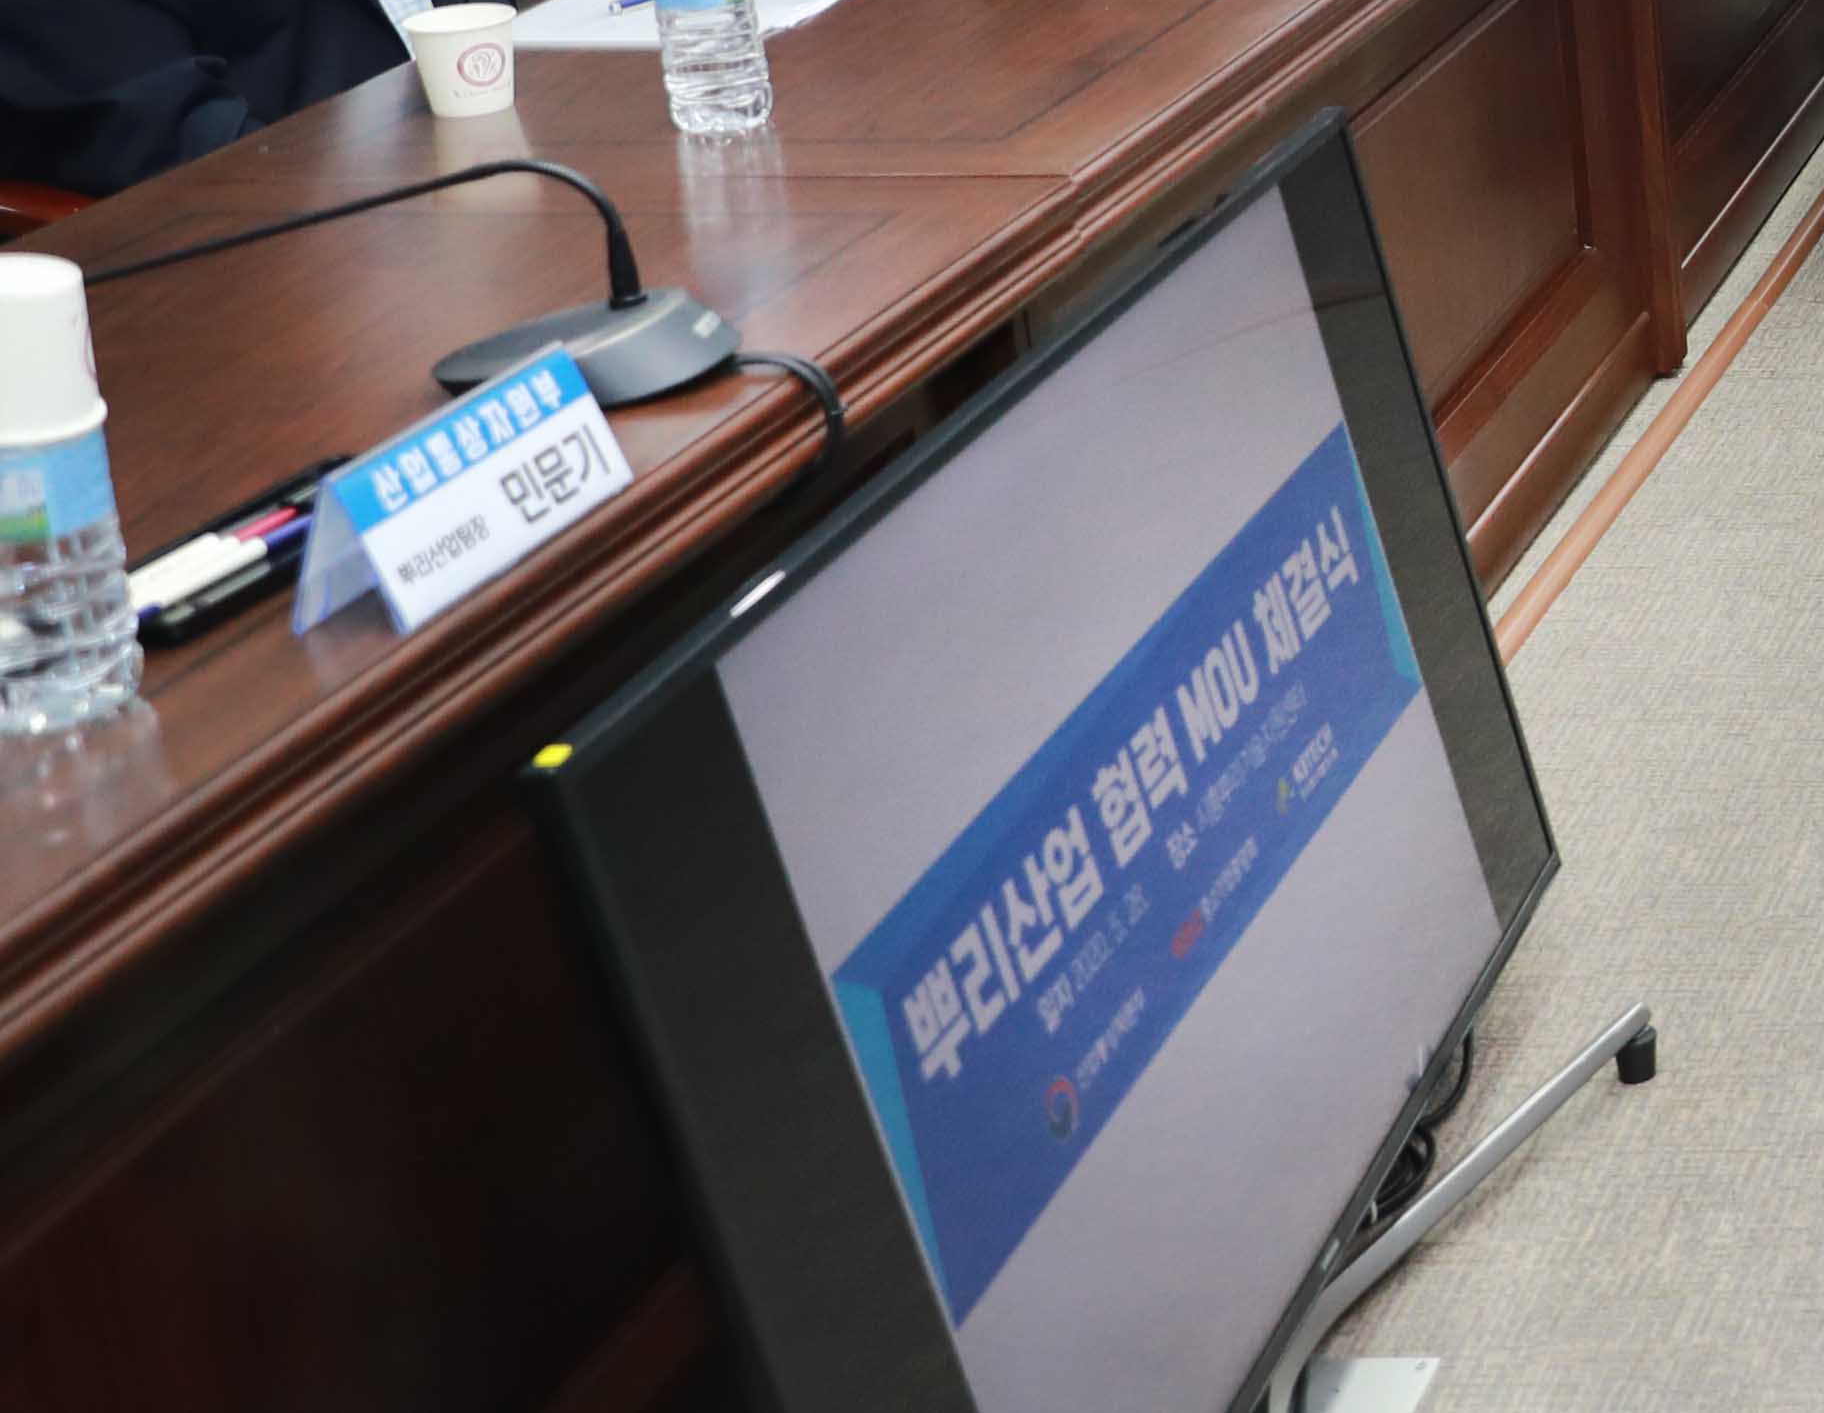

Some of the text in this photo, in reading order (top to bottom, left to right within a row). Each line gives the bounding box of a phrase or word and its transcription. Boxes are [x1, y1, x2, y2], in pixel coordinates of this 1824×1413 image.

[371, 368, 563, 513] 산업통상자원부
[499, 422, 612, 525] 민문기
[904, 805, 1104, 1078] 뿌리산업
[1092, 707, 1188, 867] 협력
[1177, 621, 1259, 762] MOU
[1254, 507, 1359, 674] 체결식
